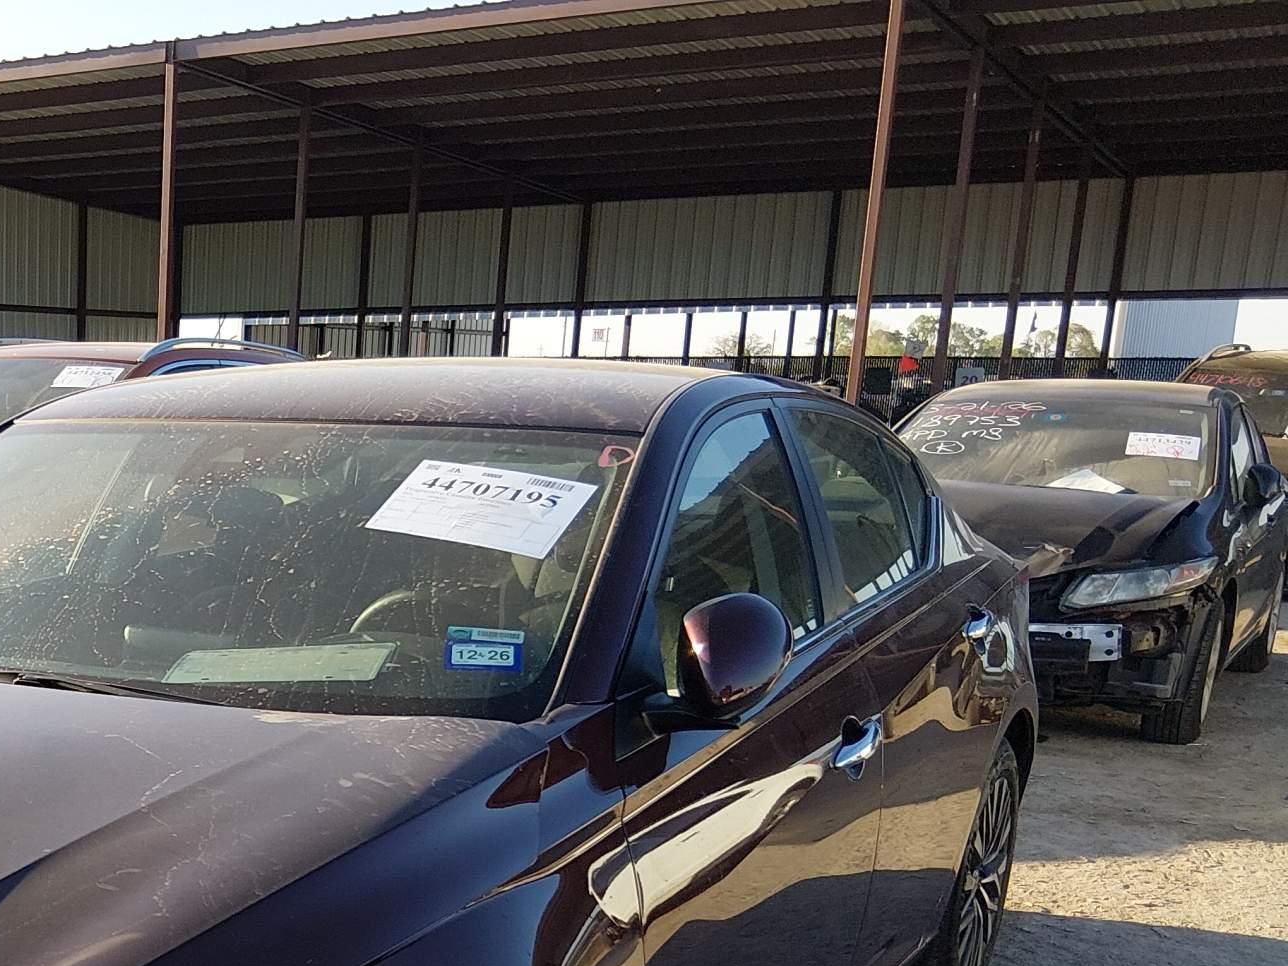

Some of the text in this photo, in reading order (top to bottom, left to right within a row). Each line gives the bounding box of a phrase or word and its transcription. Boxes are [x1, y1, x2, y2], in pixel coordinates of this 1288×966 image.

[421, 476, 564, 509] 44707195
[456, 650, 511, 661] 12 26
